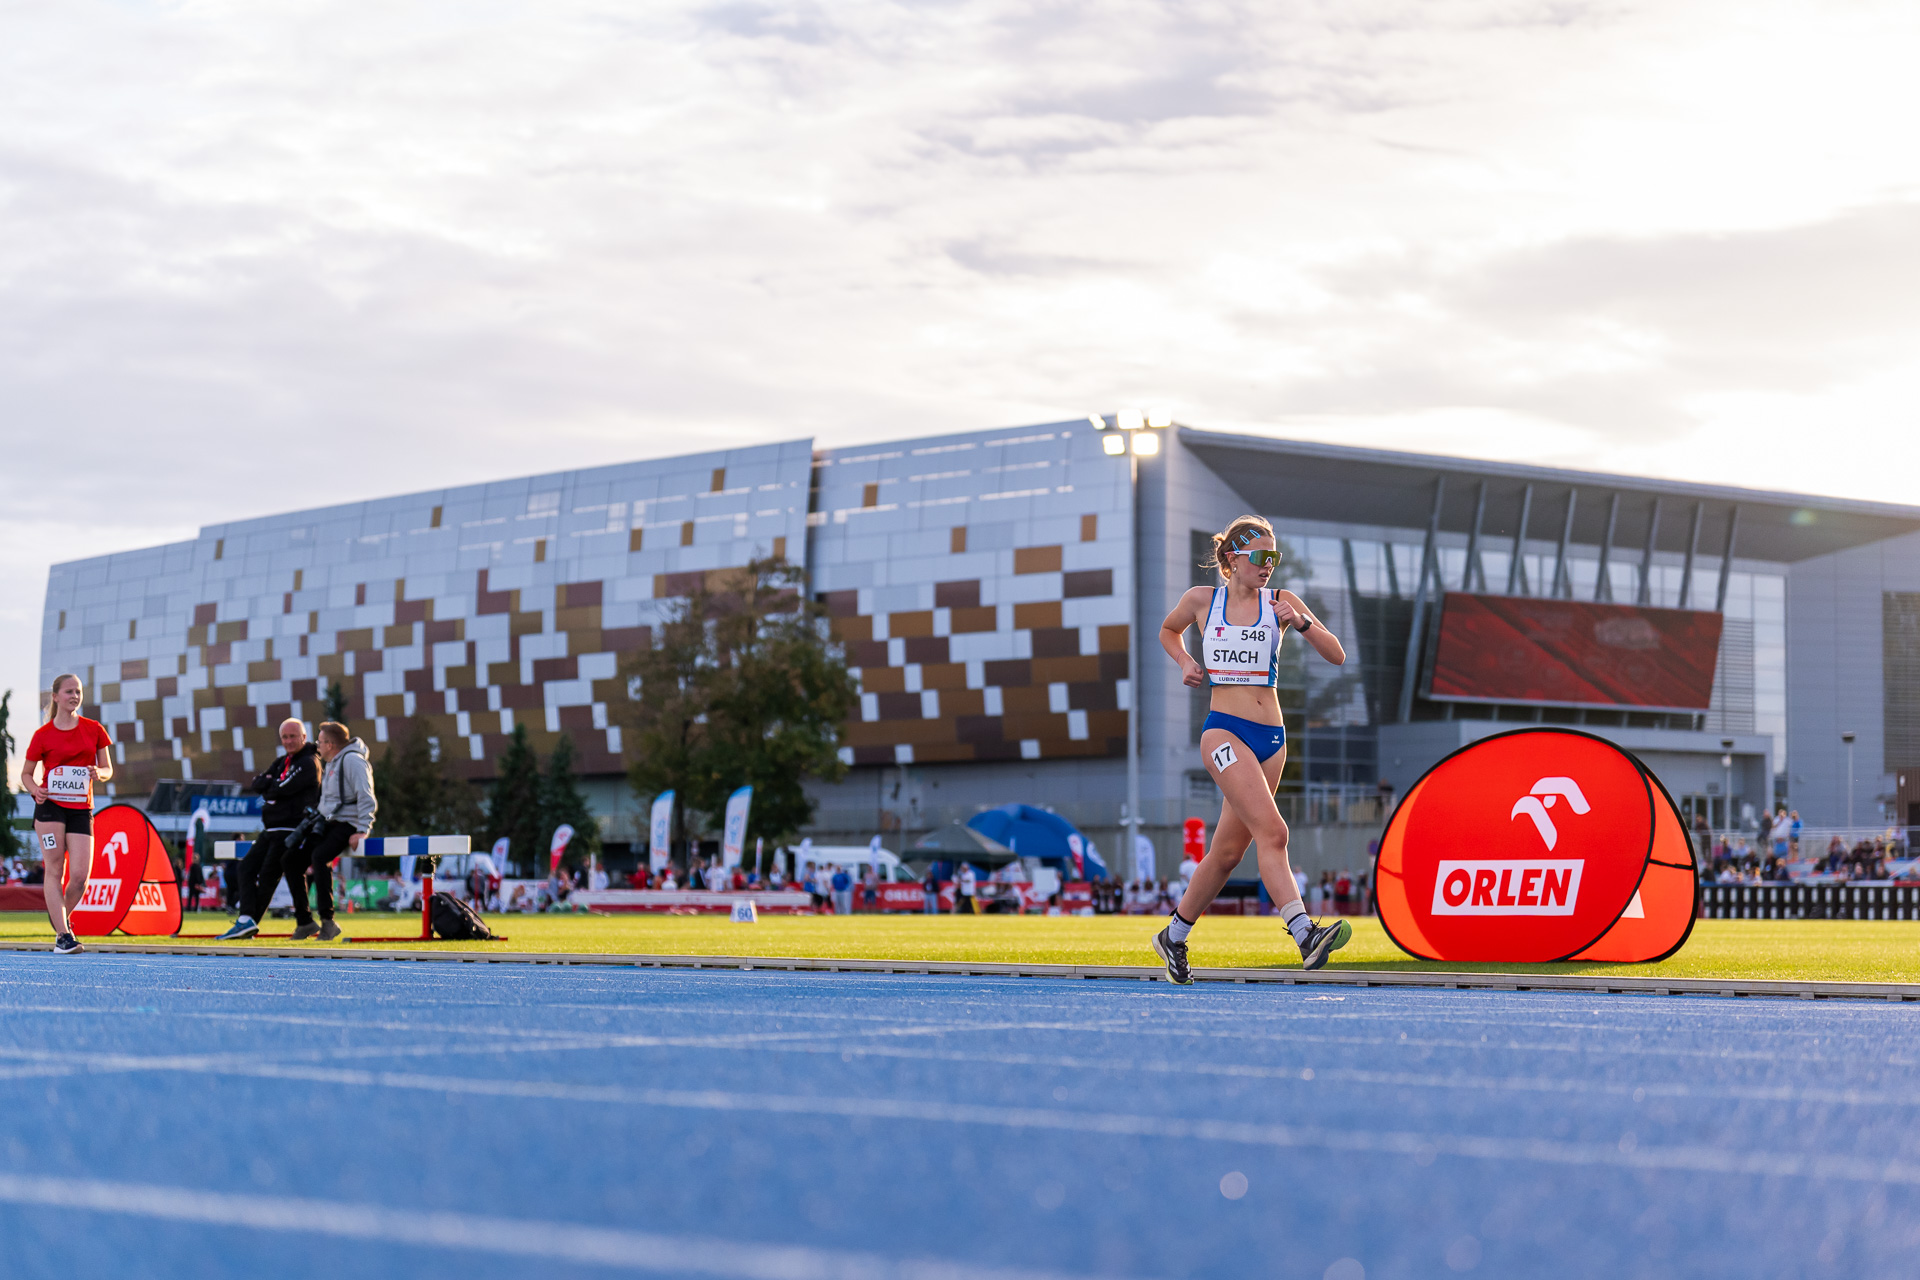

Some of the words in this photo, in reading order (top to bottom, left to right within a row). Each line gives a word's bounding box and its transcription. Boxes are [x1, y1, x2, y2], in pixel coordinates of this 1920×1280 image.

[1241, 630, 1265, 641] 548
[1213, 649, 1258, 664] STACH
[1214, 745, 1231, 767] 17
[72, 768, 87, 776] 905
[52, 780, 85, 790] PĘKALA
[43, 835, 55, 847] 15
[1442, 868, 1573, 907] ORLEN
[80, 884, 117, 906] RLEN
[737, 907, 752, 920] 60
